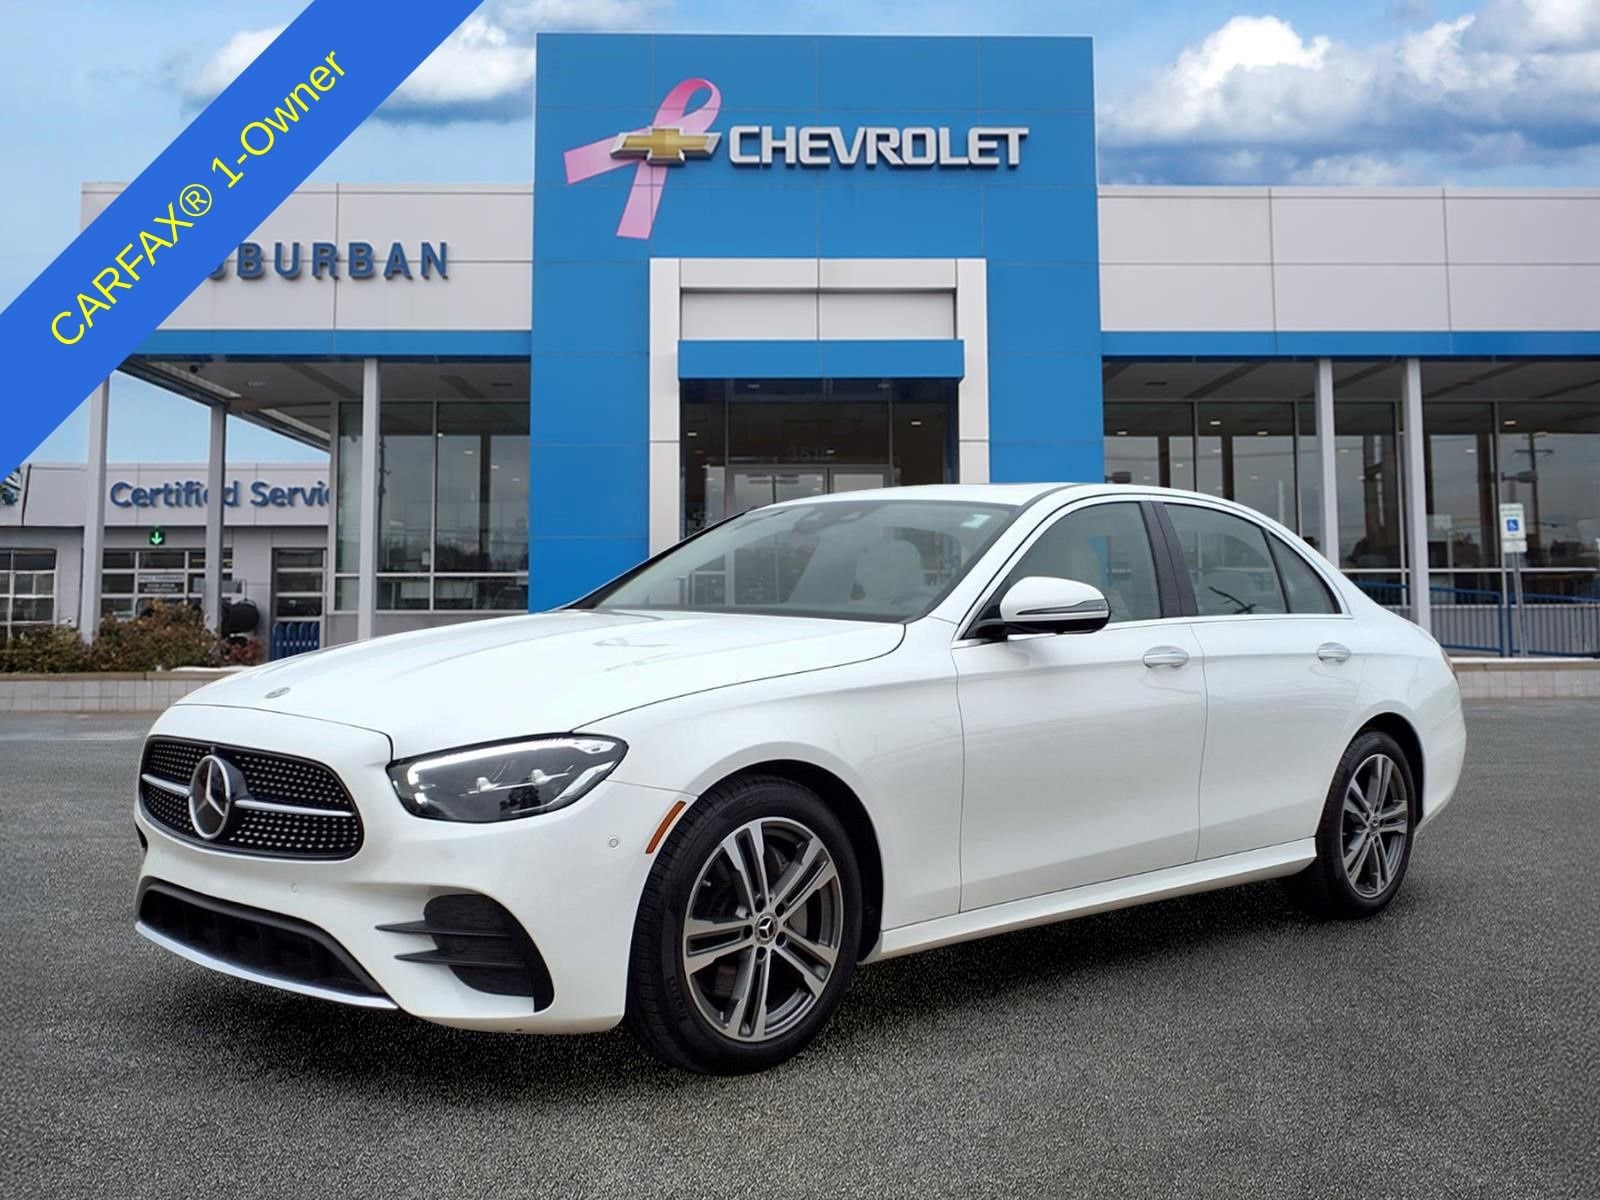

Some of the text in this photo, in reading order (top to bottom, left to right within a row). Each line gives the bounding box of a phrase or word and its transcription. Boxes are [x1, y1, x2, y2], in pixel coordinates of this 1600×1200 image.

[729, 125, 1029, 168] CHEVROLET
[209, 242, 449, 280] BURBAN
[110, 481, 330, 508] Certifid Servi
